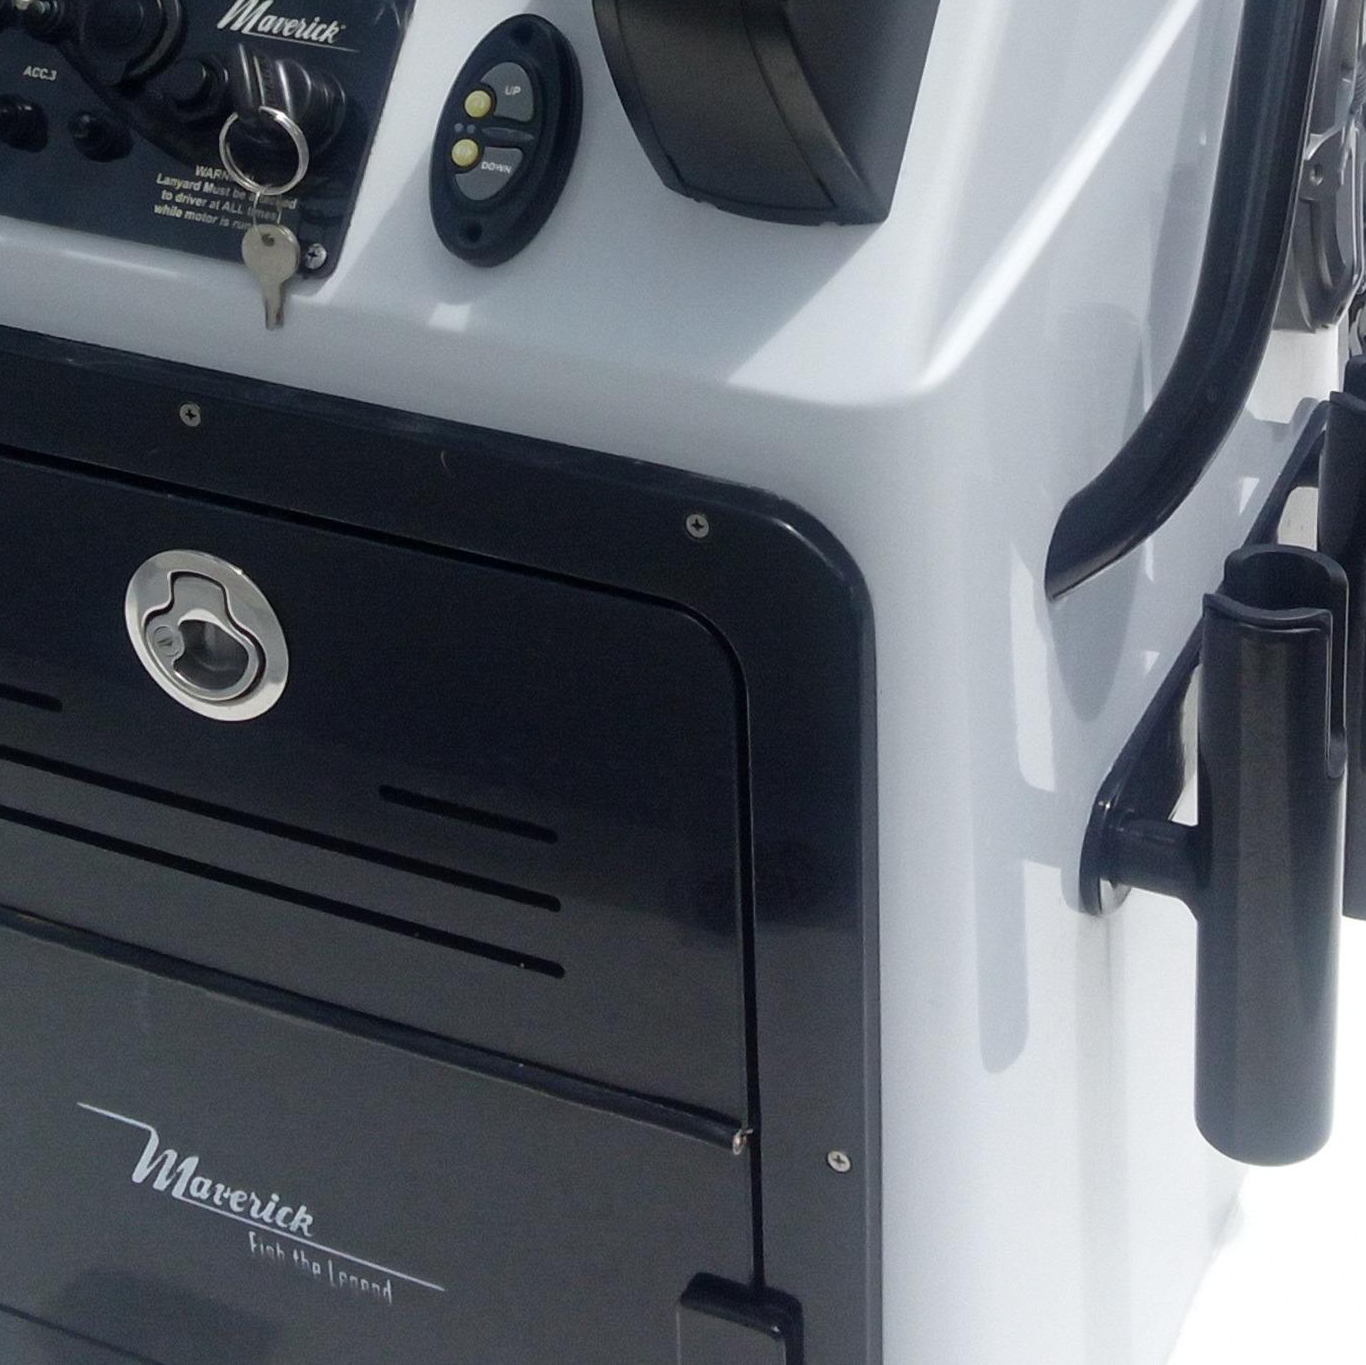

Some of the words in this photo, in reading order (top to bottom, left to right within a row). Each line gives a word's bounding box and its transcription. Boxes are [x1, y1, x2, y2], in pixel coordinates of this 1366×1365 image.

[504, 85, 522, 97] UP
[481, 161, 513, 175] DOWN
[156, 172, 202, 192] Lanyard
[202, 181, 231, 198] Must
[232, 188, 247, 201] be
[161, 189, 174, 201] to
[174, 192, 208, 208] driver
[208, 199, 220, 211] at
[221, 201, 244, 215] ALL
[154, 203, 183, 219] while
[184, 209, 218, 224] motor
[219, 216, 230, 228] is
